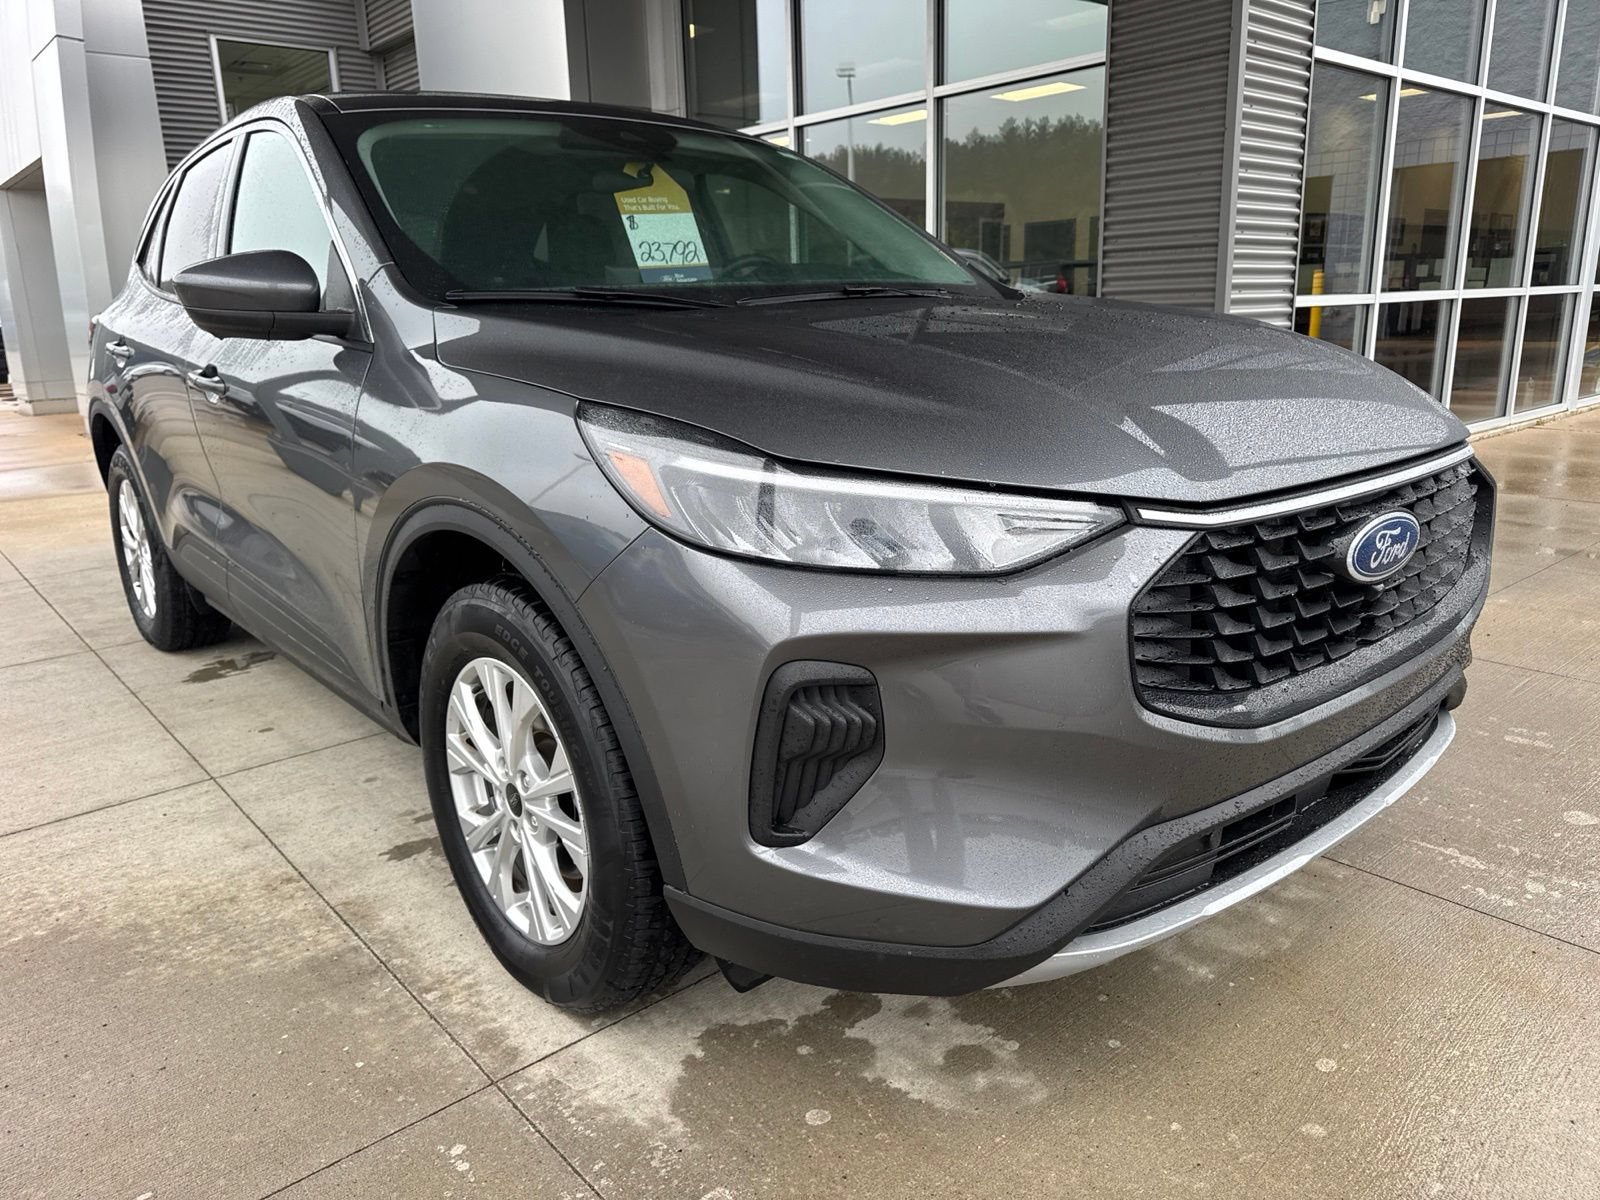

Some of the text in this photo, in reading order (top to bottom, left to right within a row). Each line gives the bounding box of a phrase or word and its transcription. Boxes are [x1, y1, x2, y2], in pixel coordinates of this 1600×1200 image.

[648, 196, 668, 205] Buying
[639, 240, 701, 265] 23,792
[1370, 526, 1411, 569] Ford
[494, 624, 529, 660] EDGE
